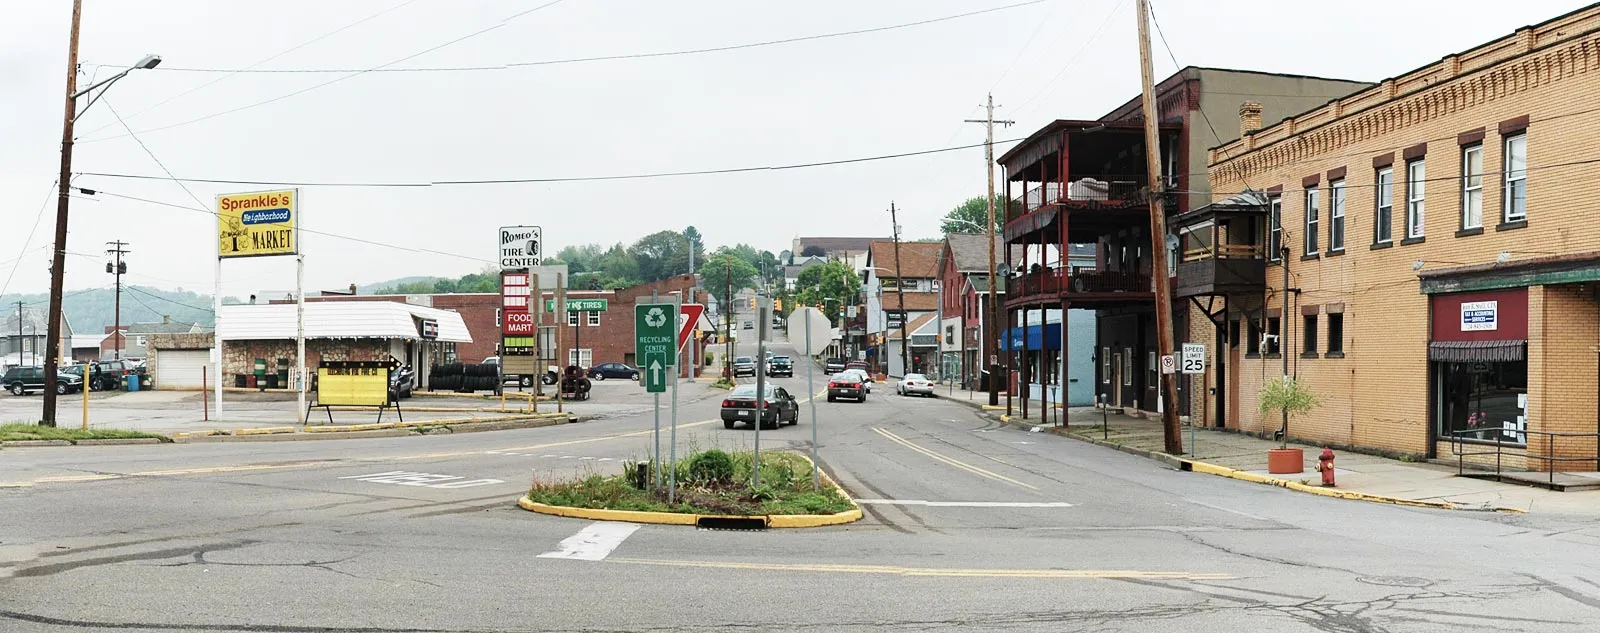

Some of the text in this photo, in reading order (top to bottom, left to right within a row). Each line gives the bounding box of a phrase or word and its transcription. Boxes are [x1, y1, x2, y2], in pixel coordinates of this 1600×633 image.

[221, 194, 290, 212] Sprankle's
[242, 210, 289, 224] Neighborhood
[252, 229, 292, 250] MARKET
[502, 248, 524, 256] TIRE
[502, 258, 539, 267] CENTER
[582, 301, 602, 309] TIRES
[507, 313, 532, 322] FOOD
[508, 323, 532, 332] MART
[644, 344, 667, 352] CENTER
[1184, 359, 1203, 371] 25
